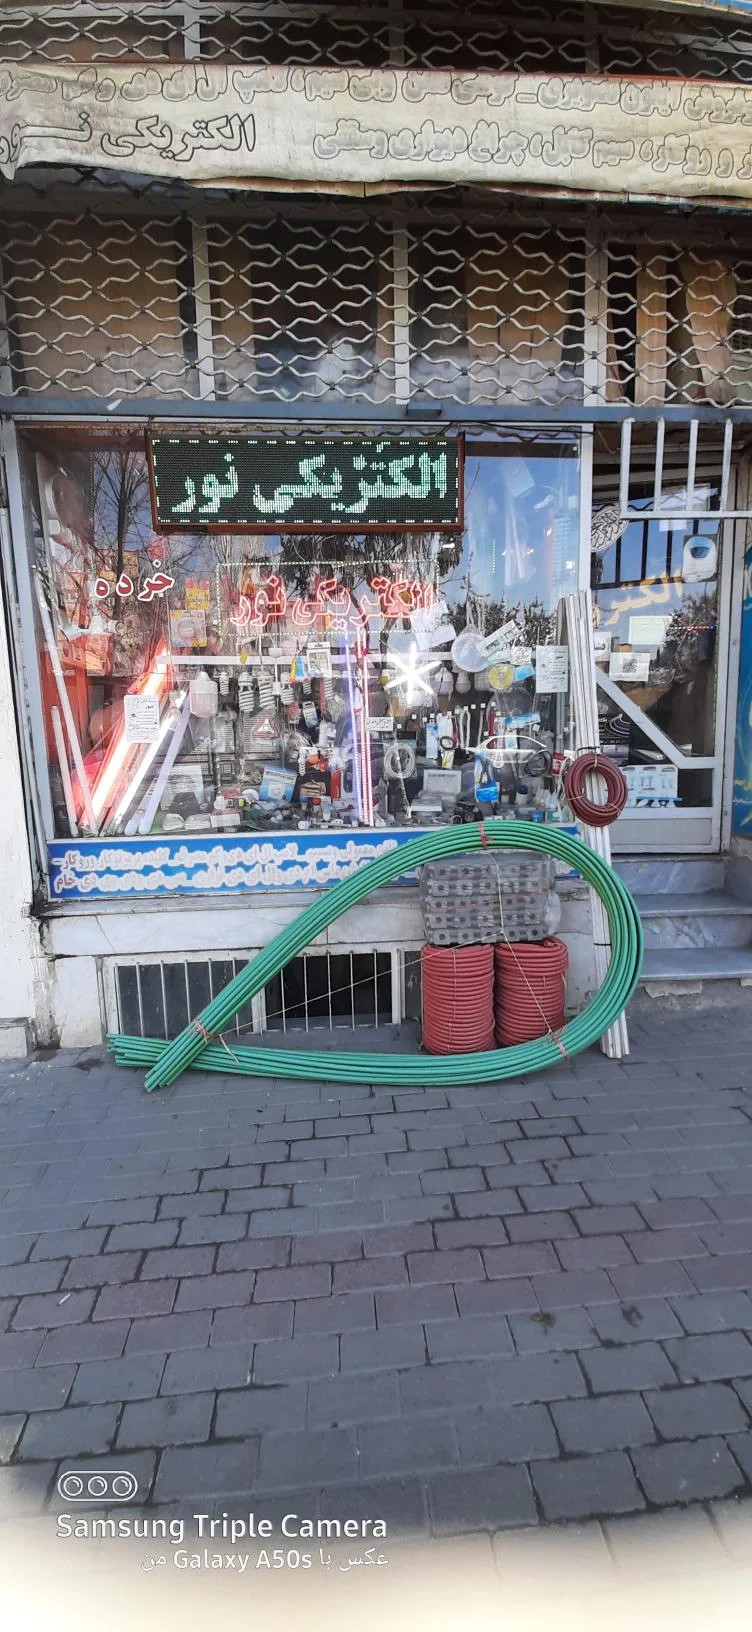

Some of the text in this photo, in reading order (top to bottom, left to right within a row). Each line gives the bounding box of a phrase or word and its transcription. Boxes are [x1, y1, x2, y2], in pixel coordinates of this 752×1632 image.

[537, 76, 621, 112] تصویری
[100, 113, 256, 162] الکتریکی
[388, 119, 469, 163] دیواری
[468, 119, 529, 167] چراغ
[592, 139, 635, 168] سیم
[171, 453, 239, 513] نور
[94, 559, 175, 601] خرده
[230, 573, 434, 630] الکتریکی نور
[54, 870, 78, 894] خام
